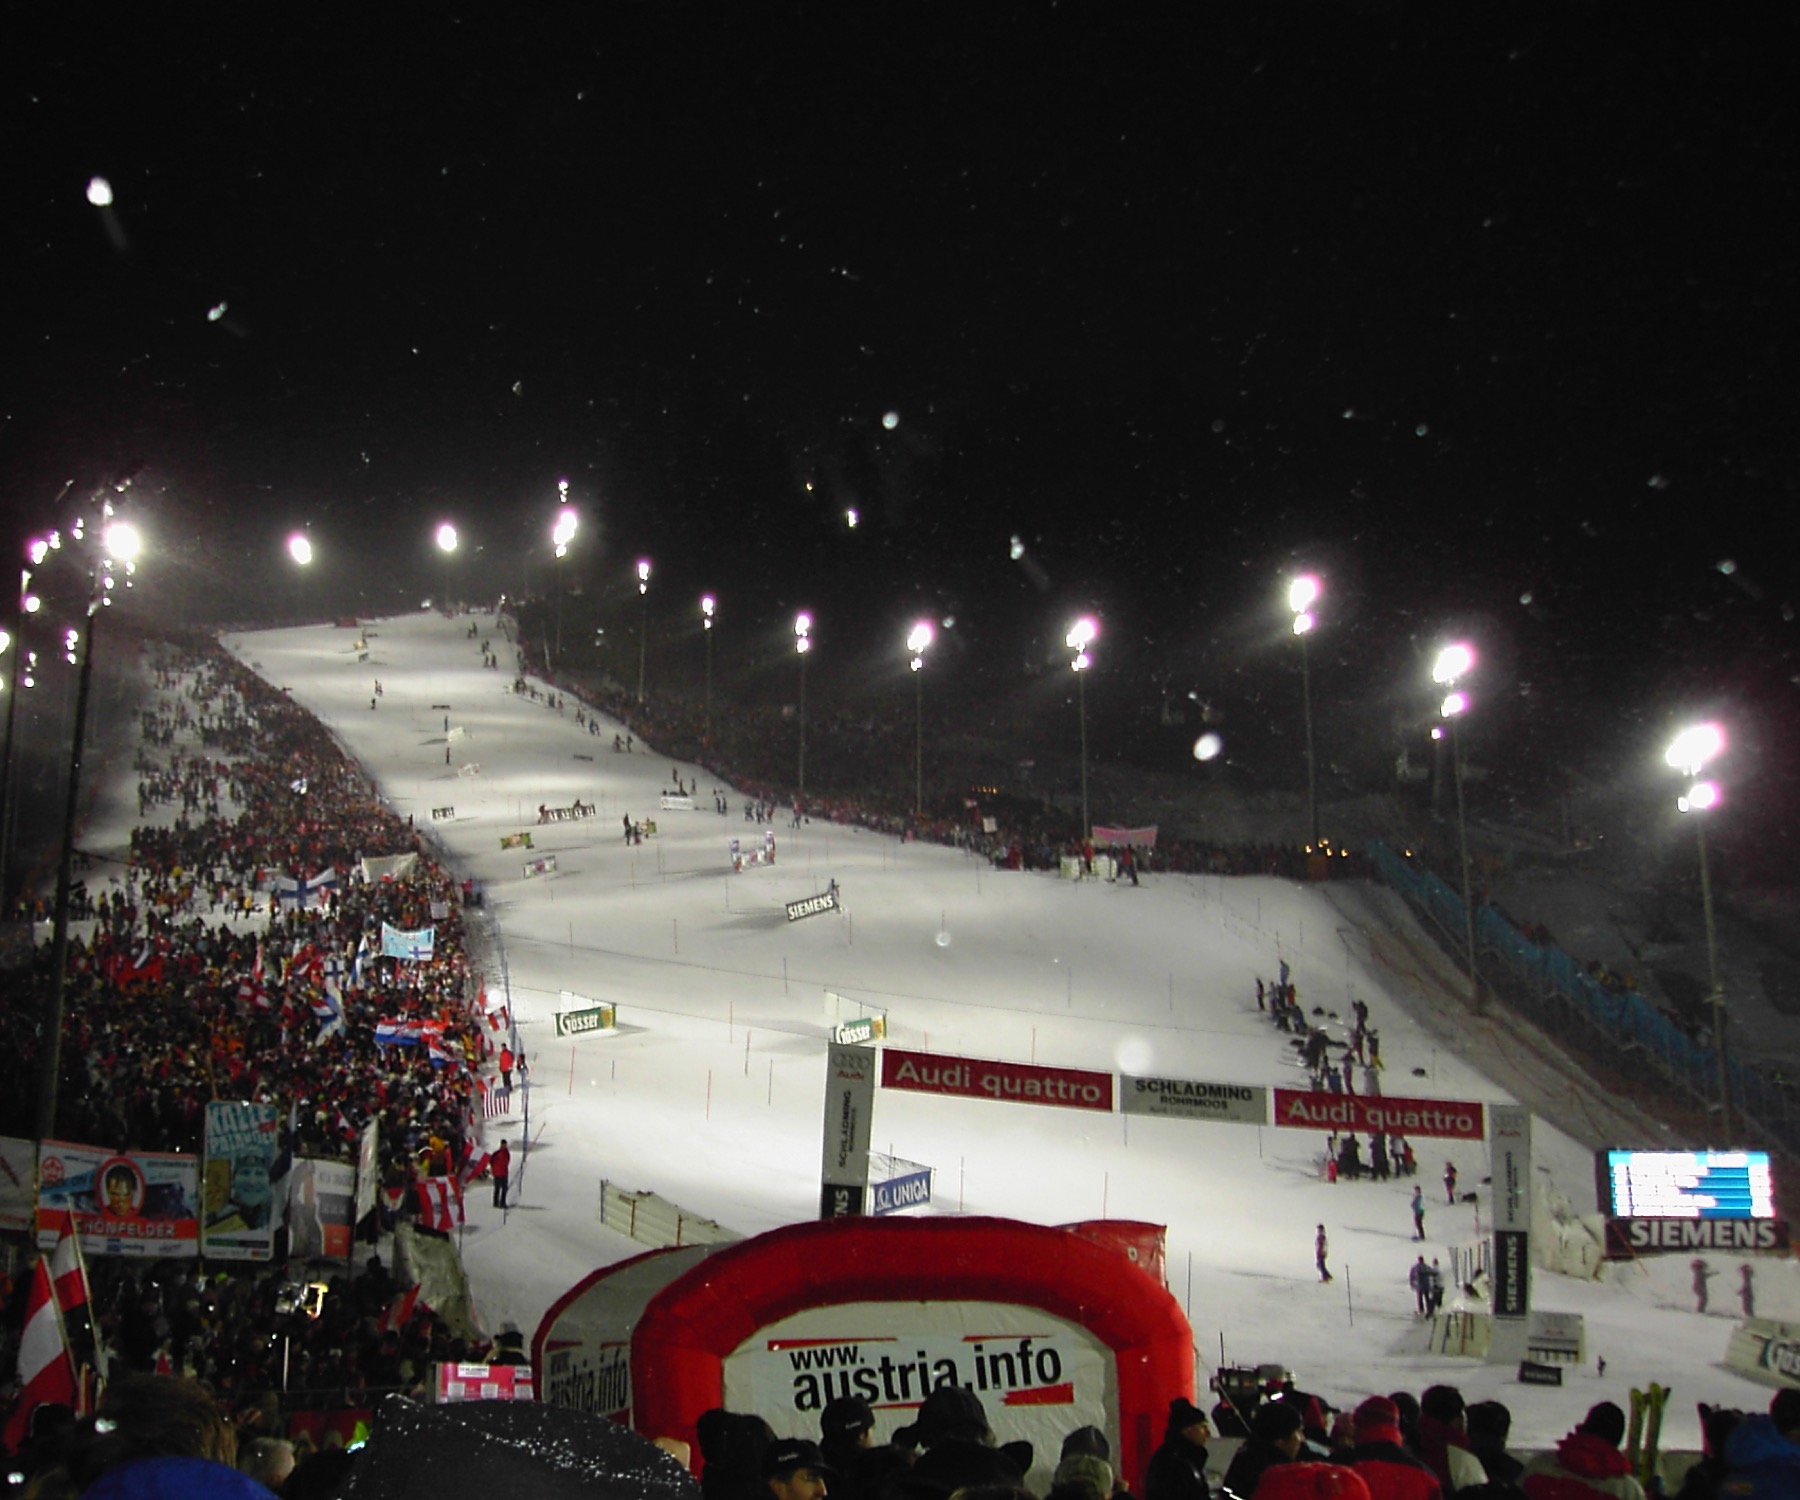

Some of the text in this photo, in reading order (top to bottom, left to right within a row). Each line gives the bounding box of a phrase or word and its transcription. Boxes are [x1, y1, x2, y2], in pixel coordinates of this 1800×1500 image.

[787, 895, 834, 920] SIEMENS
[559, 1013, 599, 1037] Gösser
[895, 1060, 1100, 1102] Audi quattro
[1135, 1078, 1254, 1102] SCHLADMING
[1159, 1095, 1229, 1110] ROHRMOOS
[1288, 1100, 1474, 1132] Audi quattro
[839, 1090, 852, 1168] SCHLADMING
[892, 1178, 929, 1207] UNIQA
[1629, 1219, 1777, 1249] SIEMENS
[1506, 1235, 1518, 1312] SIEMENS
[790, 1344, 866, 1371] www.
[793, 1339, 1062, 1412] austria.info
